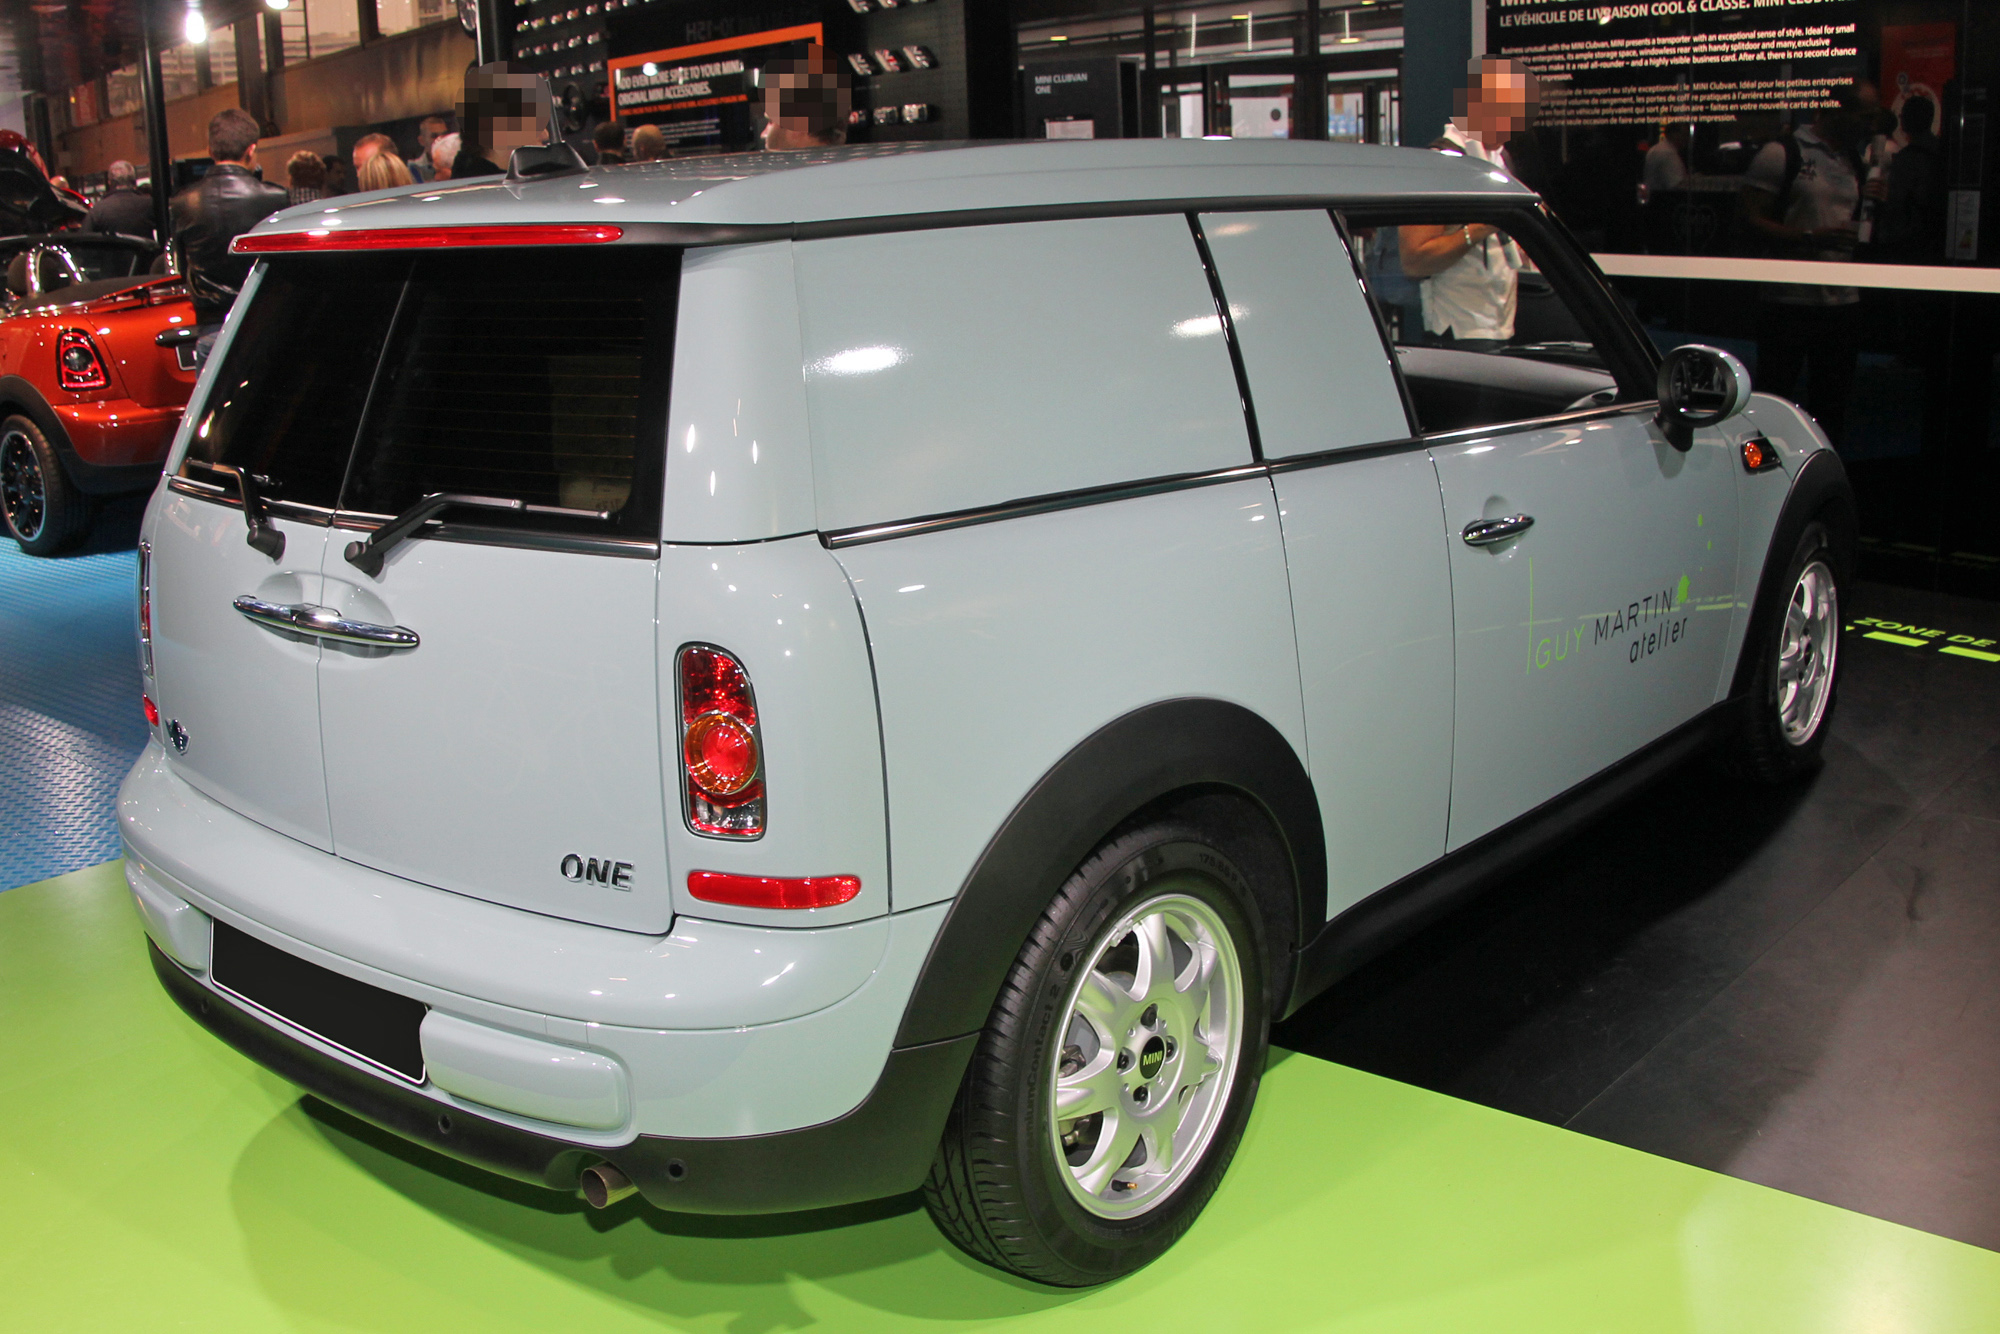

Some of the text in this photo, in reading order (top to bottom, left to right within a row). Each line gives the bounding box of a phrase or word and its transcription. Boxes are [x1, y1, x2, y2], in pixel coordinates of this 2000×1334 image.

[1500, 15, 1512, 27] LE
[1514, 10, 1567, 26] VÉHICULE
[1569, 9, 1584, 22] DE
[1586, 4, 1648, 21] LIVRAISON
[1651, 1, 1685, 16] COOL
[1687, 0, 1697, 13] &
[1700, 0, 1750, 12] CLASSE.
[1571, 41, 1585, 50] MINI
[1610, 39, 1625, 48] MINI
[1626, 38, 1651, 48] presents
[1657, 35, 1692, 45] transporter
[1692, 33, 1707, 42] with
[1717, 29, 1756, 42] exceptional
[1757, 30, 1777, 39] sense
[1777, 27, 1786, 37] of
[1786, 27, 1804, 39] style.
[1805, 25, 1823, 36] Ideal
[1824, 24, 1835, 35] for
[1835, 23, 1856, 34] small
[1639, 46, 1676, 56] windowless
[1677, 46, 1691, 54] rear
[1692, 44, 1707, 53] with
[1708, 42, 1730, 53] handy
[1730, 40, 1761, 52] splitdoor
[1761, 39, 1775, 49] and
[1797, 37, 1831, 47] exclusive
[1630, 58, 1643, 67] and
[1649, 57, 1670, 67] highly
[1670, 56, 1691, 65] visible
[1692, 54, 1720, 64] business
[1720, 53, 1737, 62] card.
[1738, 51, 1755, 61] After
[1756, 51, 1766, 60] all,
[1767, 50, 1786, 60] there
[1787, 49, 1792, 59] is
[1794, 50, 1803, 58] no
[1804, 47, 1830, 57] second
[1831, 47, 1857, 57] chance
[690, 65, 700, 79] TO
[700, 62, 721, 78] YOUR
[1035, 72, 1088, 84] MINI CLUBVAN
[1035, 85, 1052, 95] ONE
[1693, 81, 1708, 90] MINI
[1709, 81, 1738, 90] Clubvan.
[1739, 80, 1757, 89] Idéal
[1758, 80, 1775, 90] pour
[1775, 79, 1785, 88] les
[1786, 78, 1811, 88] petites
[1812, 76, 1853, 87] entreprises
[618, 89, 648, 106] ORIGINAL
[648, 87, 664, 101] MINI
[1700, 92, 1731, 102] pratiques
[1765, 91, 1773, 99] et
[1774, 91, 1785, 99] ses
[1786, 88, 1819, 99] éléments
[1820, 88, 1830, 97] de
[1710, 103, 1729, 111] faites
[1740, 102, 1758, 111] votre
[1759, 100, 1788, 110] nouvelle
[1789, 101, 1808, 109] carte
[1809, 100, 1819, 109] de
[1820, 99, 1841, 109] visite.
[1535, 587, 1674, 669] GUY MARTIN
[1853, 617, 1997, 648] ZONE DE
[1629, 616, 1688, 664] atelier
[560, 853, 635, 892] ONE
[1142, 1050, 1163, 1066] MINI
